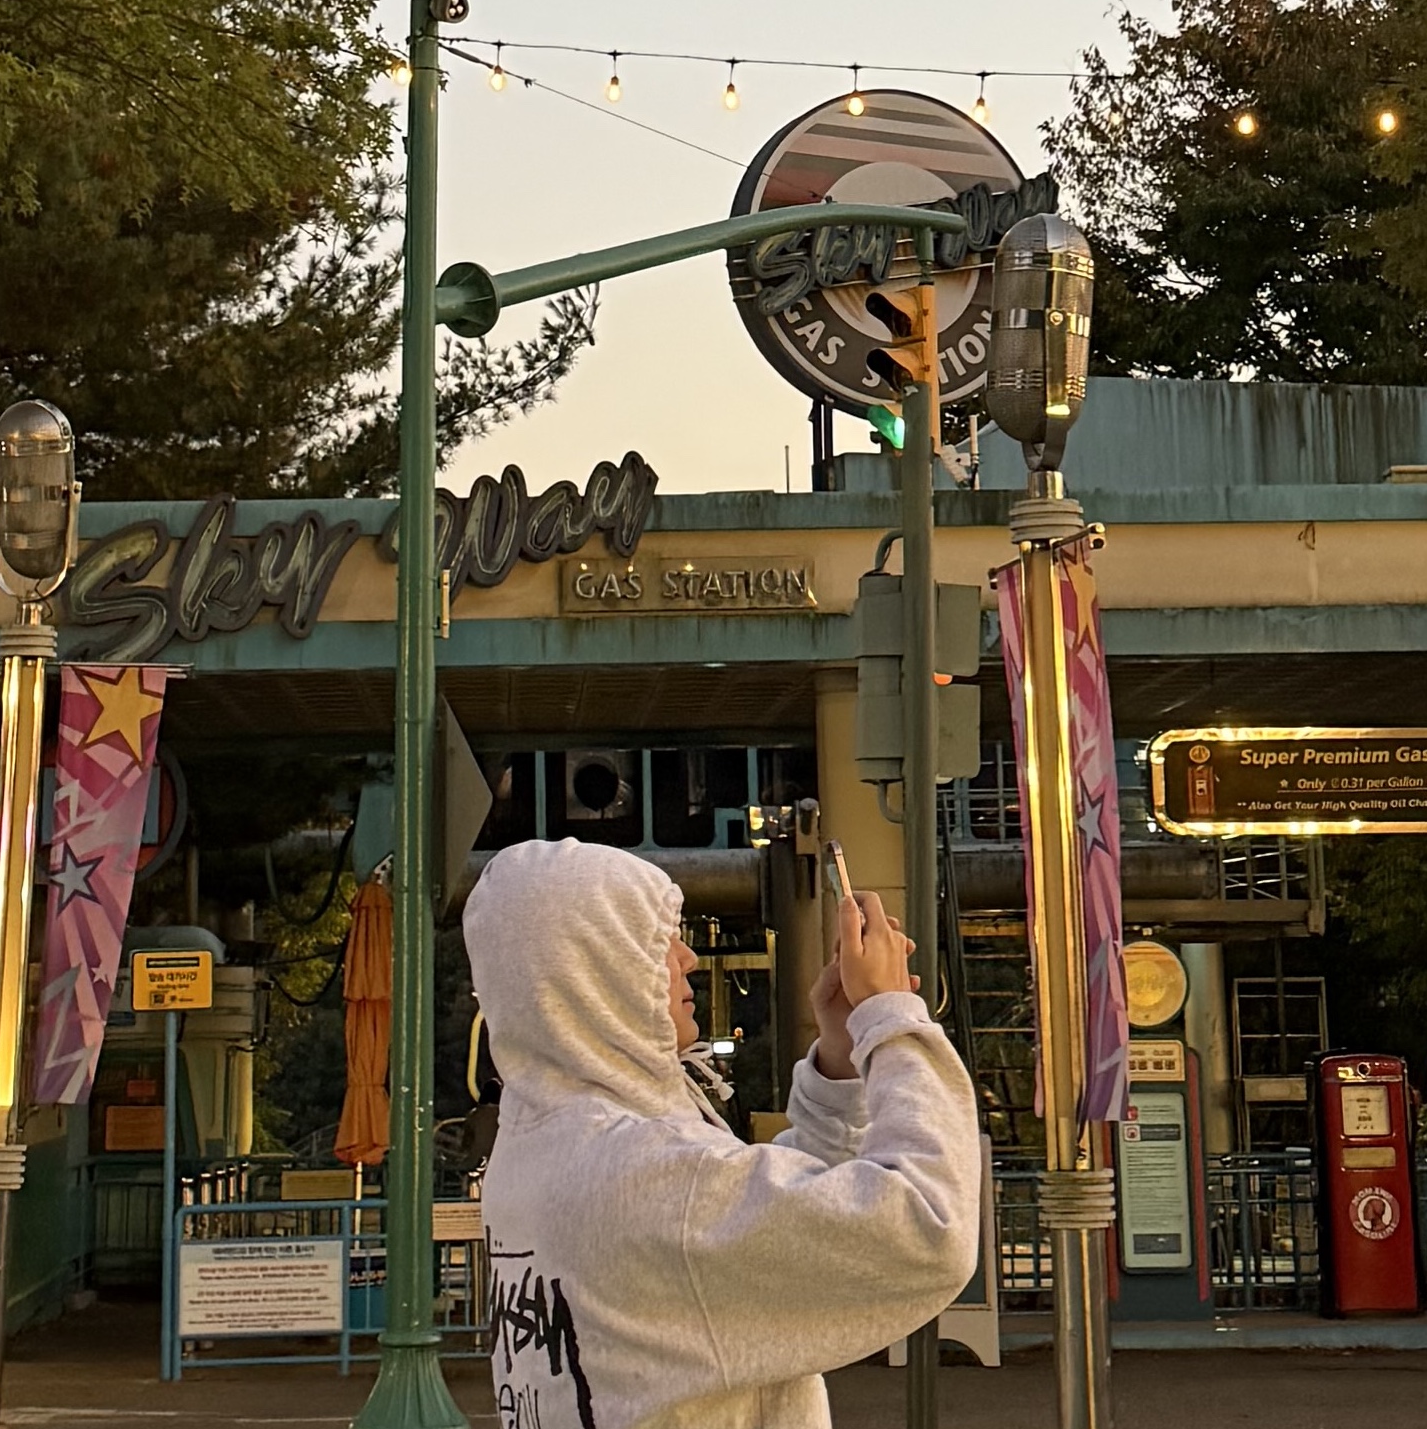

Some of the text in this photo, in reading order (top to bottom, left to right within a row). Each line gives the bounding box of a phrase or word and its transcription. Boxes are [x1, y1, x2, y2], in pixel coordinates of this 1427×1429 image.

[783, 296, 846, 366] GAS
[64, 493, 360, 661] Sky
[575, 568, 808, 600] GAS STATION
[1240, 749, 1300, 770] Super
[1303, 747, 1390, 765] Premium
[1297, 777, 1327, 792] Only
[1367, 778, 1387, 791] per
[1248, 800, 1272, 810] Also
[1274, 800, 1292, 810] Get
[1295, 800, 1320, 810] Your
[1321, 800, 1347, 812] High
[1349, 799, 1388, 811] Quality
[1390, 798, 1407, 808] Oil
